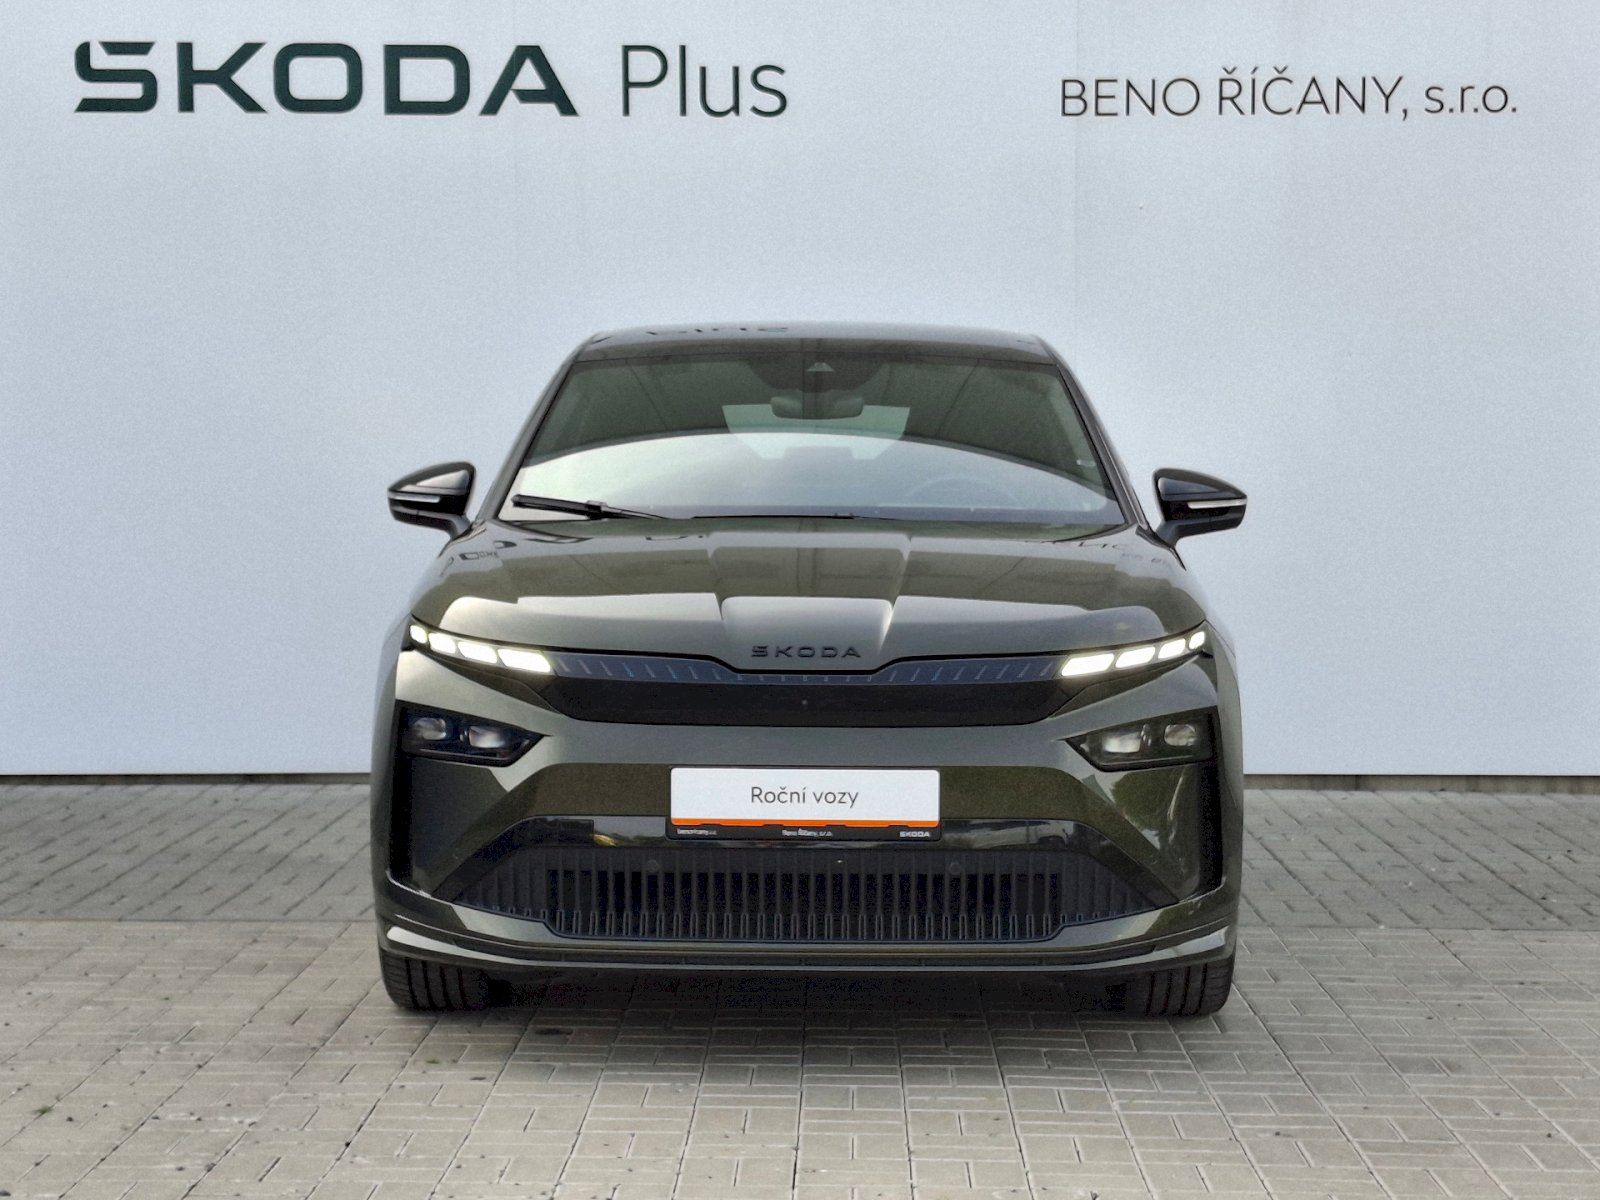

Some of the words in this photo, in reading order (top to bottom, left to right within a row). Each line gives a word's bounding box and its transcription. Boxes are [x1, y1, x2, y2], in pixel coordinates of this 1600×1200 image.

[621, 45, 788, 118] Plus
[1061, 77, 1201, 117] BENO
[1218, 66, 1408, 122] ŘÍČANY,
[1424, 85, 1517, 114] s.r.o.
[751, 786, 806, 804] Roční
[812, 790, 859, 808] vozy
